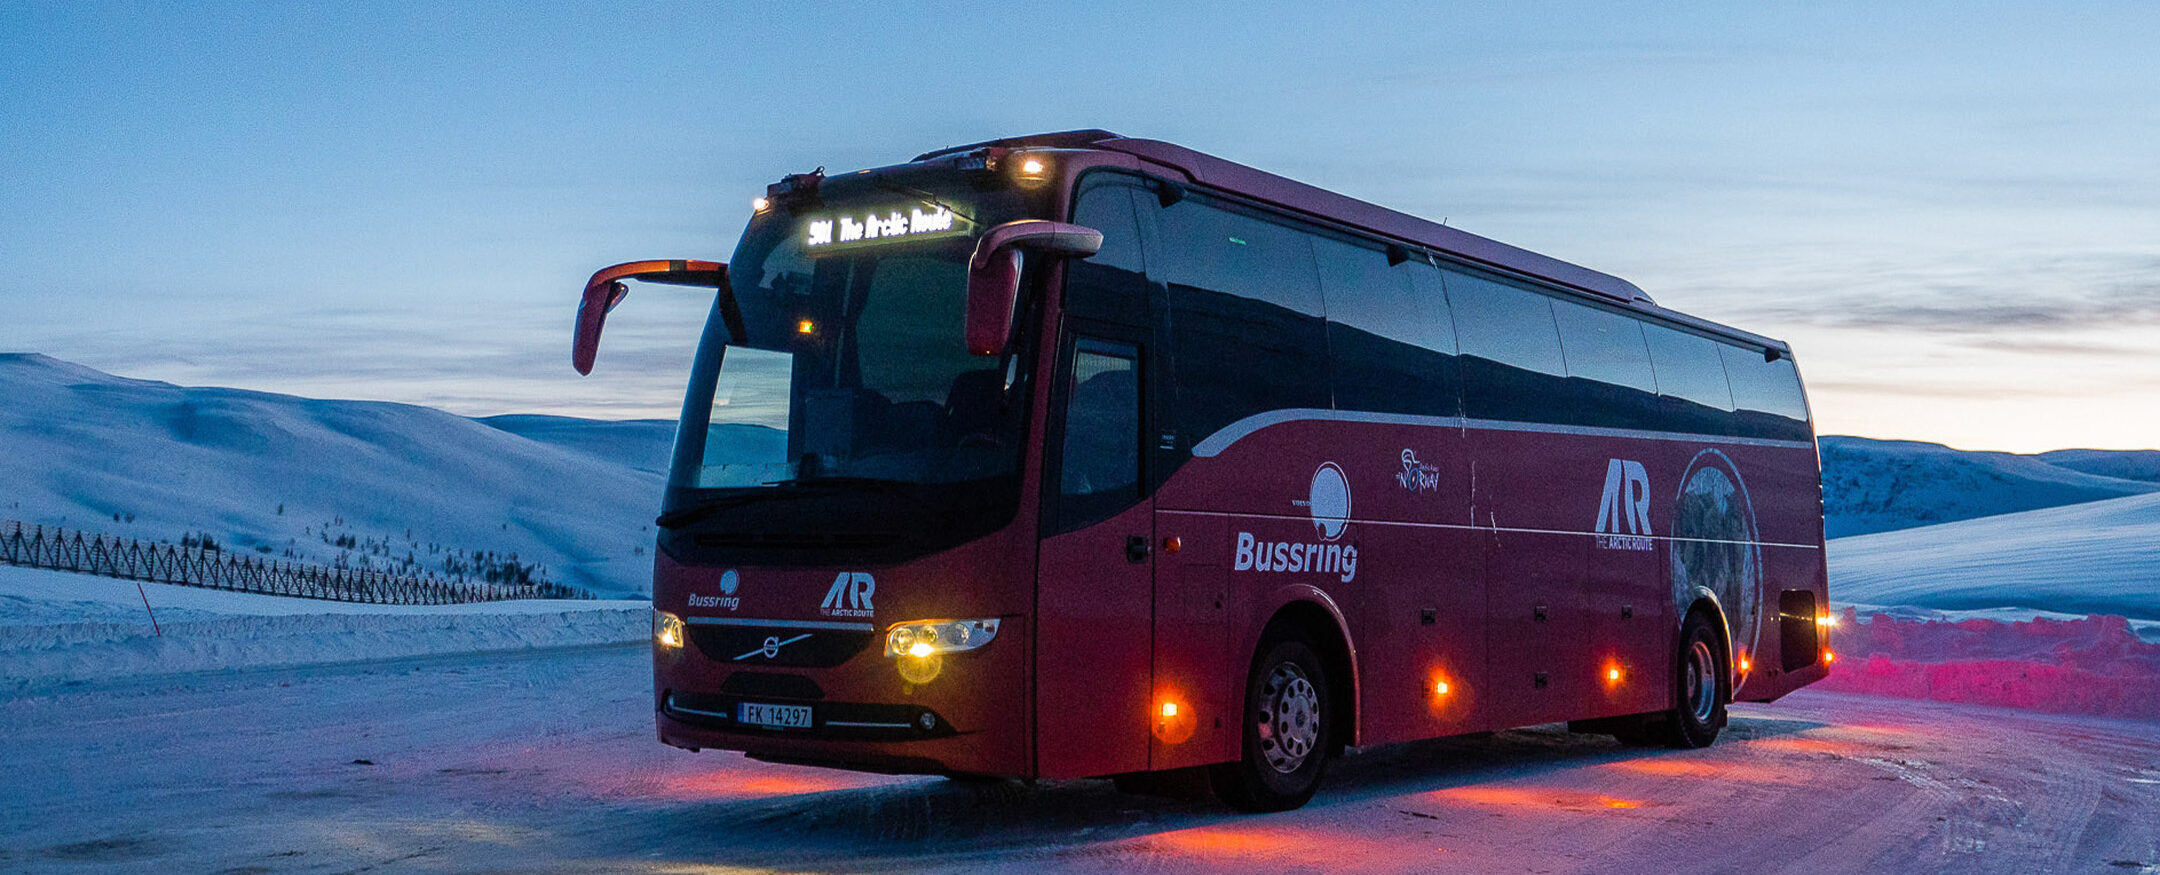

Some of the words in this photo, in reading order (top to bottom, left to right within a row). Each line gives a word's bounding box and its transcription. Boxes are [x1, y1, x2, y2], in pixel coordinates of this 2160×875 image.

[840, 218, 864, 241] The
[865, 212, 909, 238] Arctic
[910, 207, 953, 233] Route
[1595, 458, 1652, 535] AR
[1609, 535, 1631, 550] ARCTIC
[1632, 536, 1653, 551] ROUTE
[1234, 532, 1358, 583] Bussring
[688, 593, 740, 611] Bussring
[820, 571, 876, 609] AR
[831, 609, 853, 617] ARCTIC
[853, 609, 875, 618] ROUTE
[748, 706, 763, 723] FK
[769, 707, 808, 726] 14297
